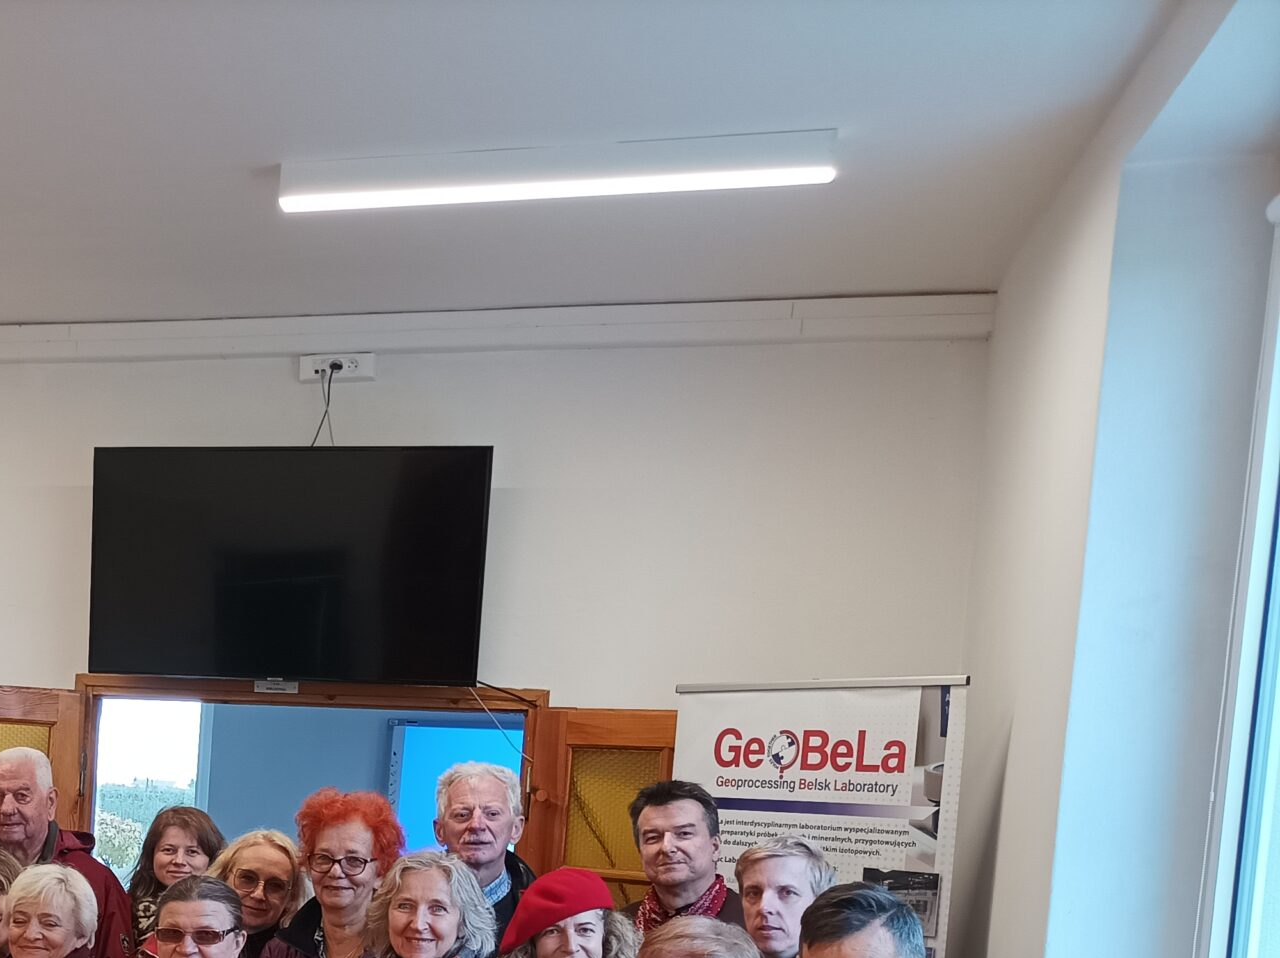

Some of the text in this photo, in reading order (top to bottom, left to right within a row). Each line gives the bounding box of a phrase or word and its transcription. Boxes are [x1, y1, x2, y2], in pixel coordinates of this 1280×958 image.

[716, 776, 899, 797] Geoprocessing Belsk Laboratory
[723, 819, 735, 827] jest
[735, 819, 798, 831] interdyscyplinarnym
[798, 822, 843, 832] laboratorium
[843, 826, 910, 837] wyspecjalizowanym
[720, 829, 756, 838] preparatyki
[811, 834, 853, 844] mineralnych,
[854, 837, 917, 849] przygotowujących
[723, 838, 732, 846] do
[838, 846, 882, 857] izotopowych.
